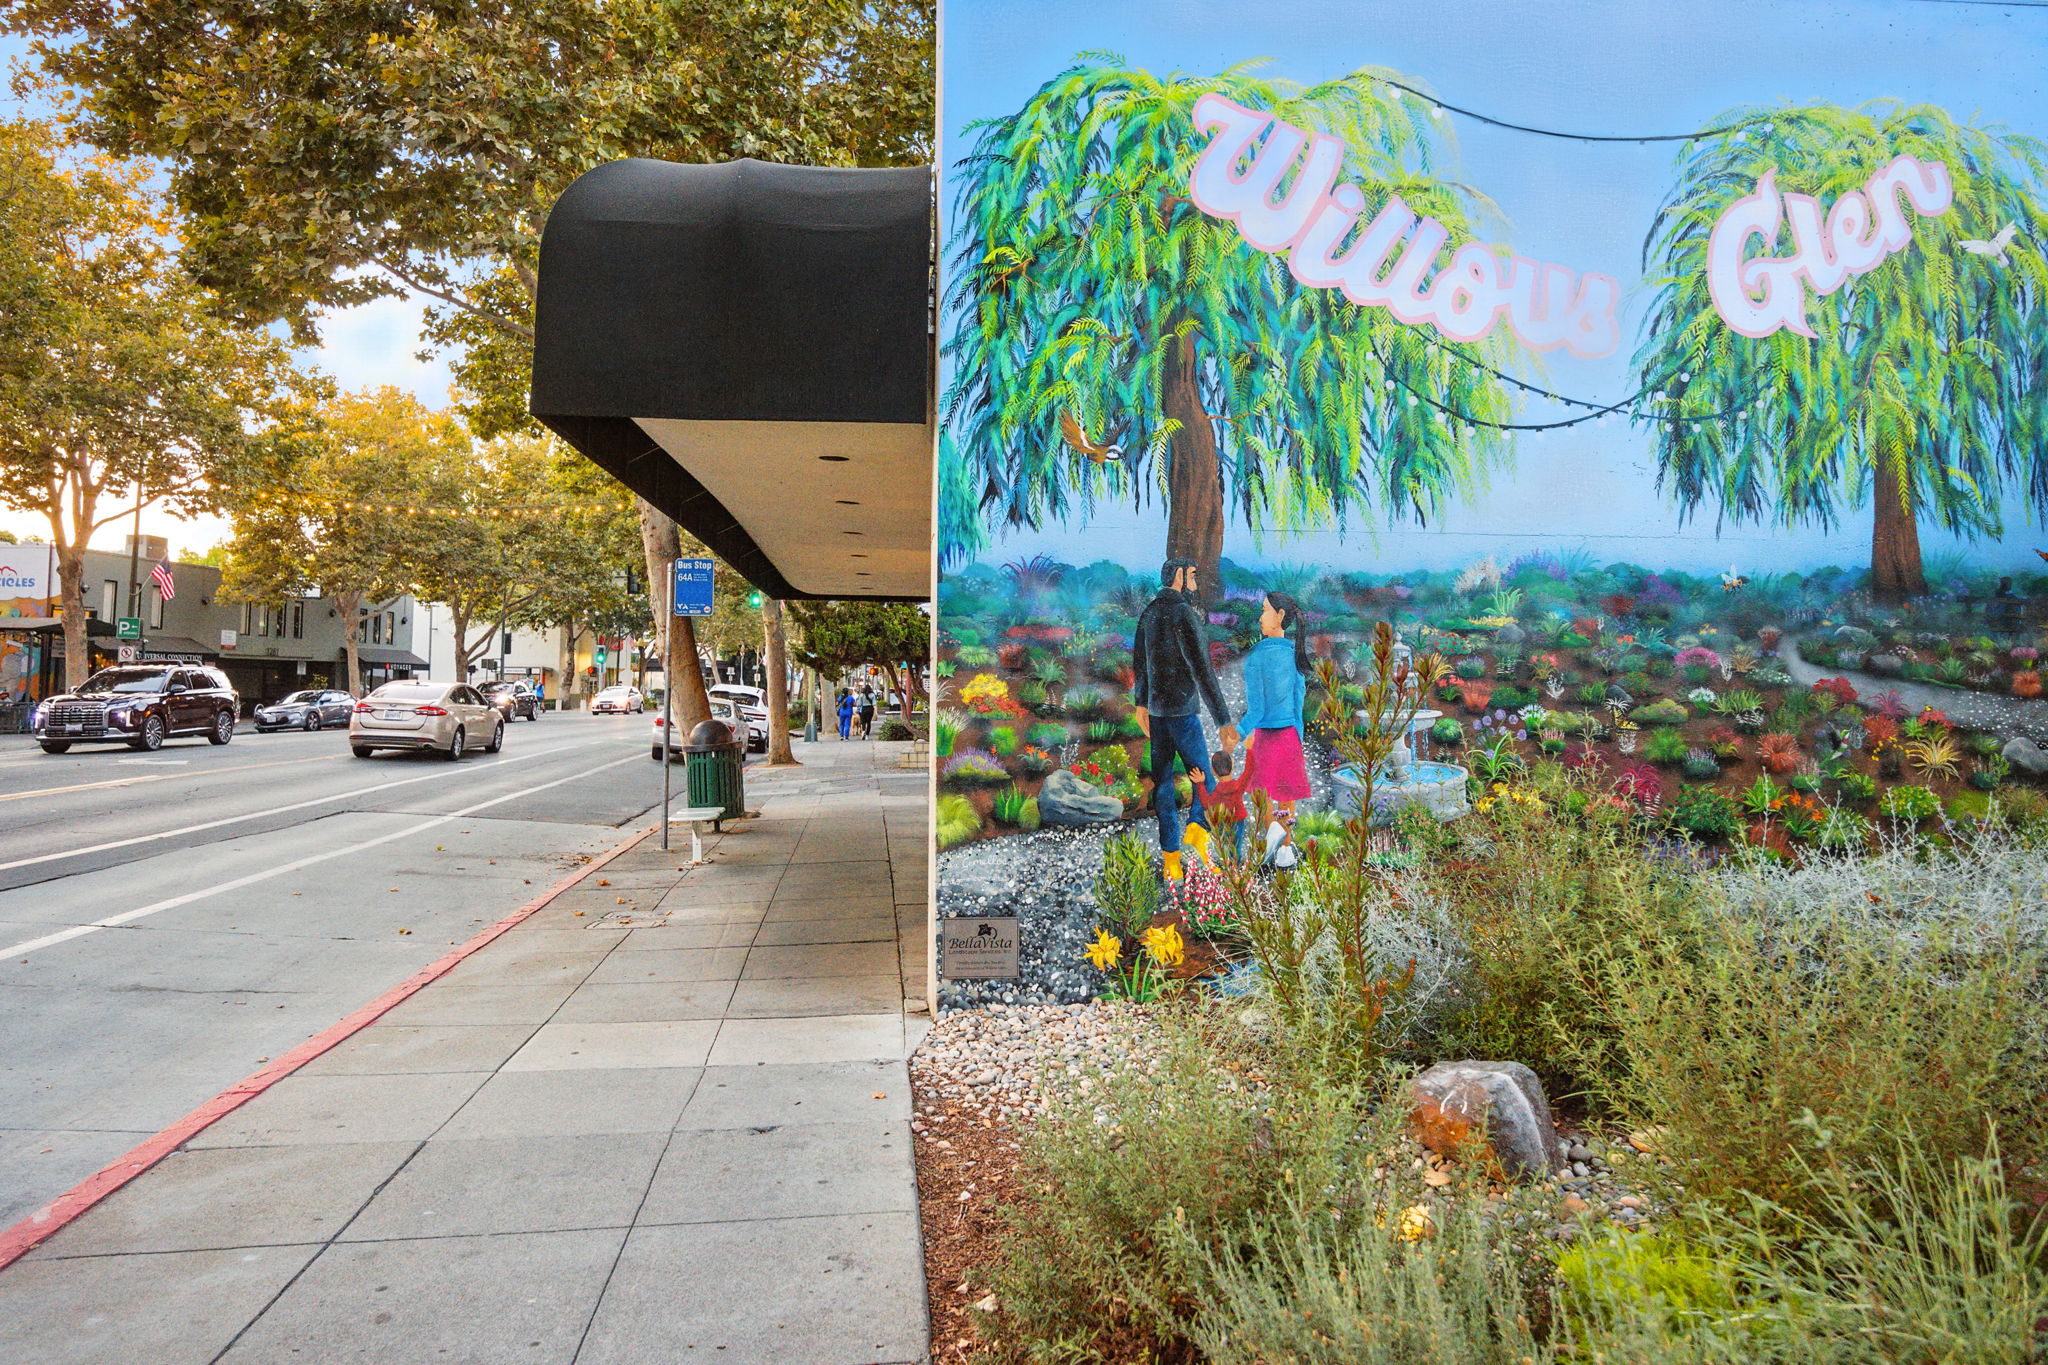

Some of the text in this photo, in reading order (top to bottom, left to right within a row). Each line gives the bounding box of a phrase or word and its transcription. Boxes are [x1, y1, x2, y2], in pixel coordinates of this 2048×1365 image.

[1189, 93, 1952, 358] Willow Glen
[678, 561, 712, 571] Bus Stop
[0, 577, 35, 587] ICLES
[678, 573, 693, 581] 64A
[119, 621, 130, 634] P
[136, 652, 166, 660] UIVERSAL
